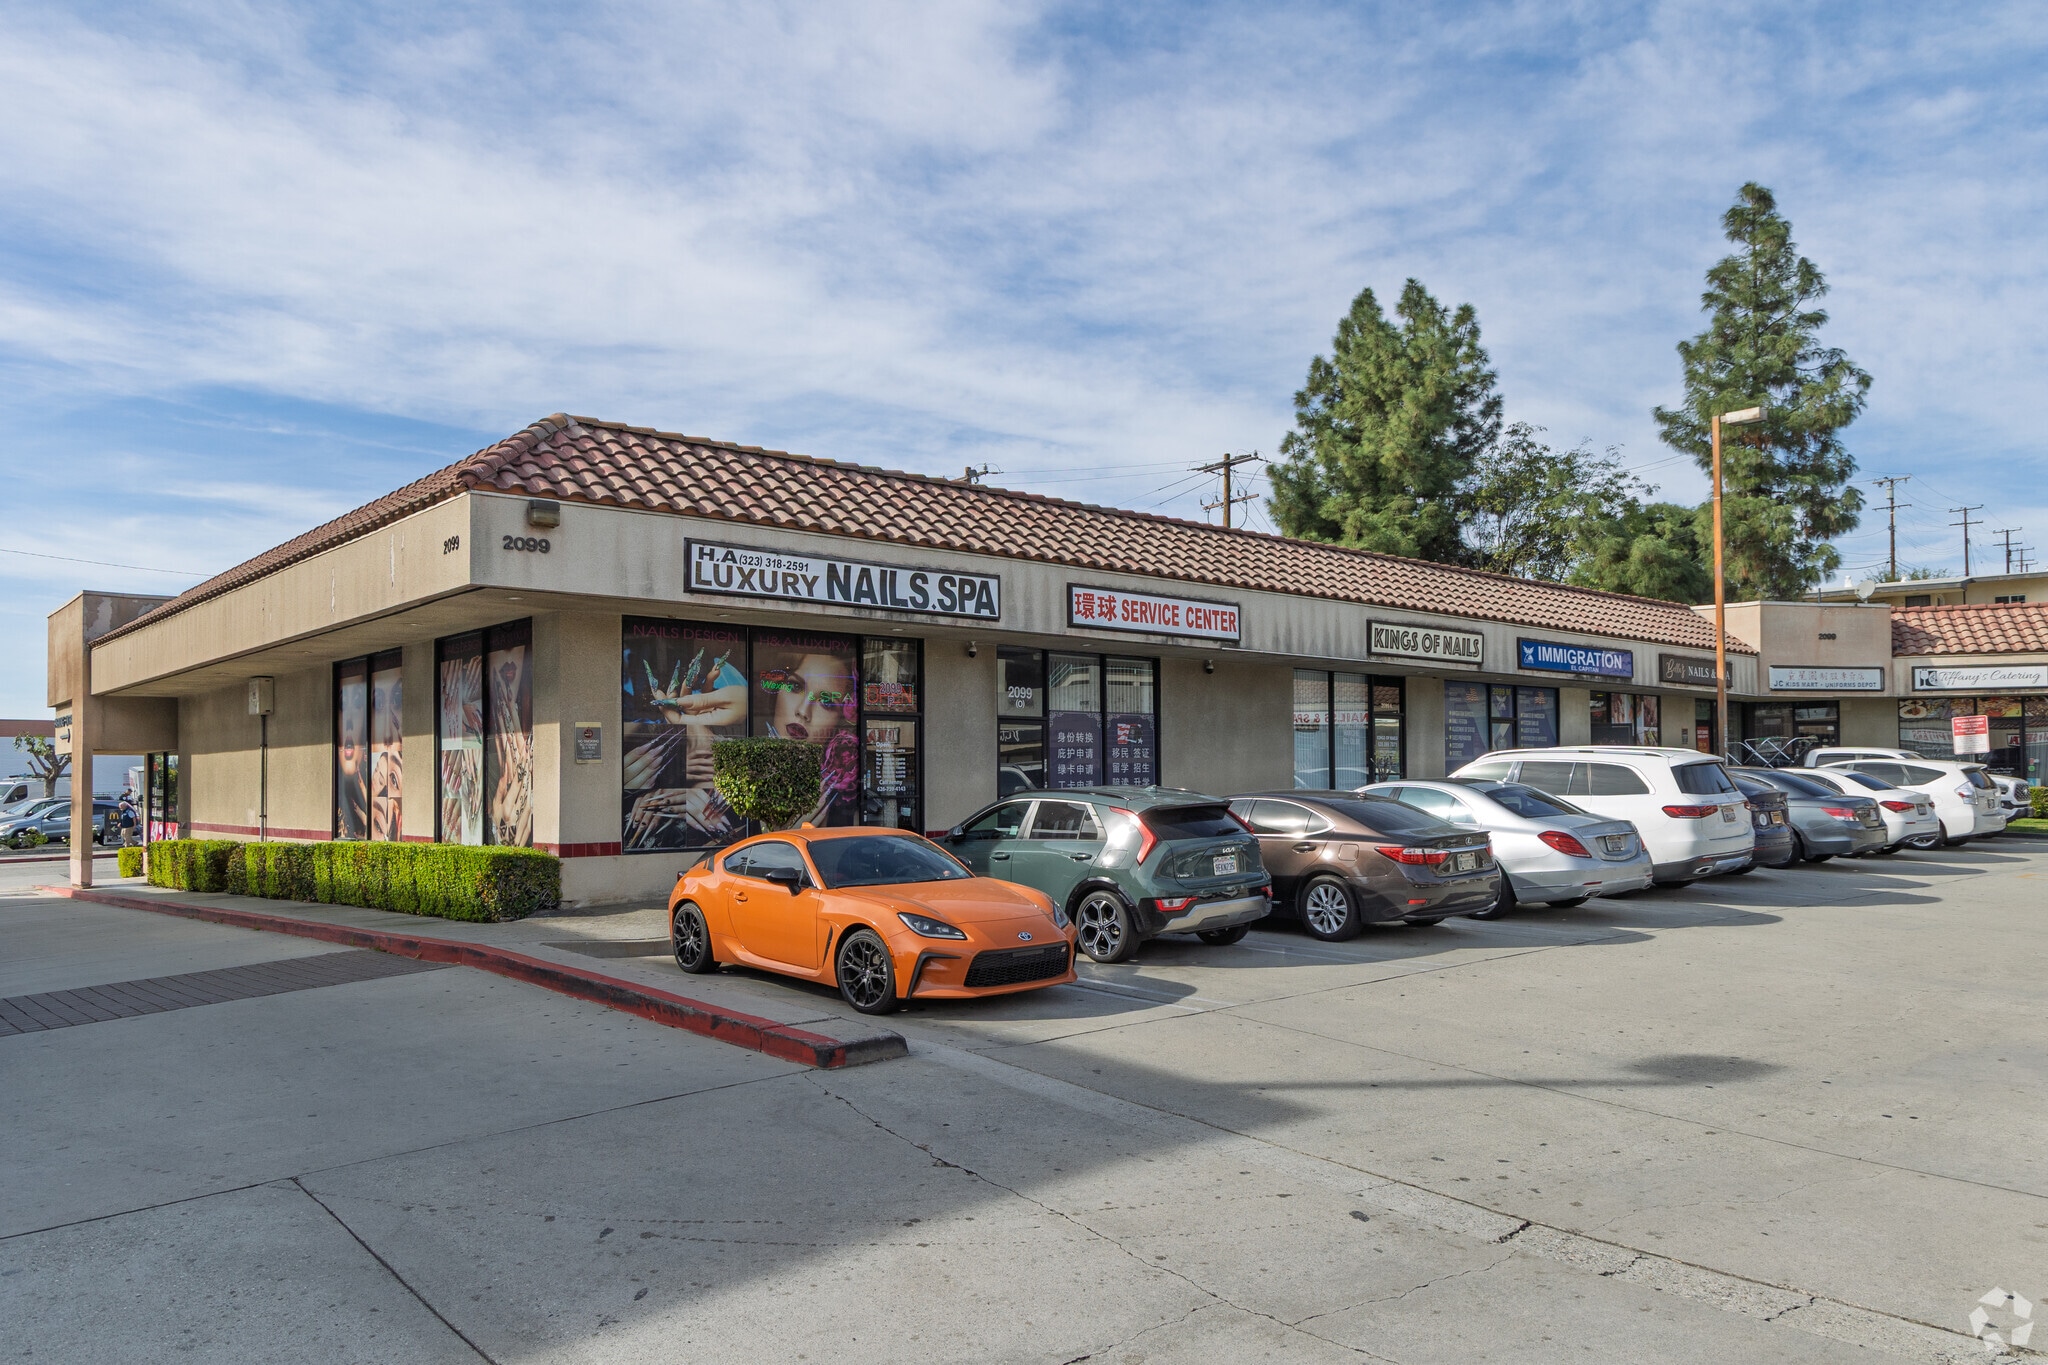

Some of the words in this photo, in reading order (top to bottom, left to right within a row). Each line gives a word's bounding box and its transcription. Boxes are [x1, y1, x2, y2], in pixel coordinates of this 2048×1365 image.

[443, 535, 460, 555] 2099
[502, 535, 551, 553] 2099
[739, 553, 762, 567] (323)
[765, 557, 809, 572] 318-2591
[695, 561, 820, 597] LUXURY
[1074, 592, 1117, 622] 環球
[1121, 599, 1180, 627] SERVICE
[1185, 606, 1237, 632] CENTER
[633, 624, 679, 639] NAILS
[683, 628, 739, 643] DESIGN
[797, 637, 849, 650] LUXURY
[1374, 627, 1418, 652] KINGS
[1421, 633, 1440, 653] OF
[1443, 635, 1480, 658] NAILS
[1537, 646, 1622, 669] IMMIGRATION
[1688, 665, 1709, 678] NAILS
[1939, 671, 1989, 685] Tiffany's
[1990, 669, 2041, 684] Catering
[1008, 685, 1033, 699] 2099
[1057, 732, 1094, 743] 身份转换
[1057, 748, 1094, 759] 庇护申请
[1112, 748, 1129, 759] 移民
[1133, 748, 1150, 759] 签证
[1057, 764, 1094, 775] 绿卡申请
[1112, 762, 1129, 773] 留学
[1133, 762, 1150, 773] 招生
